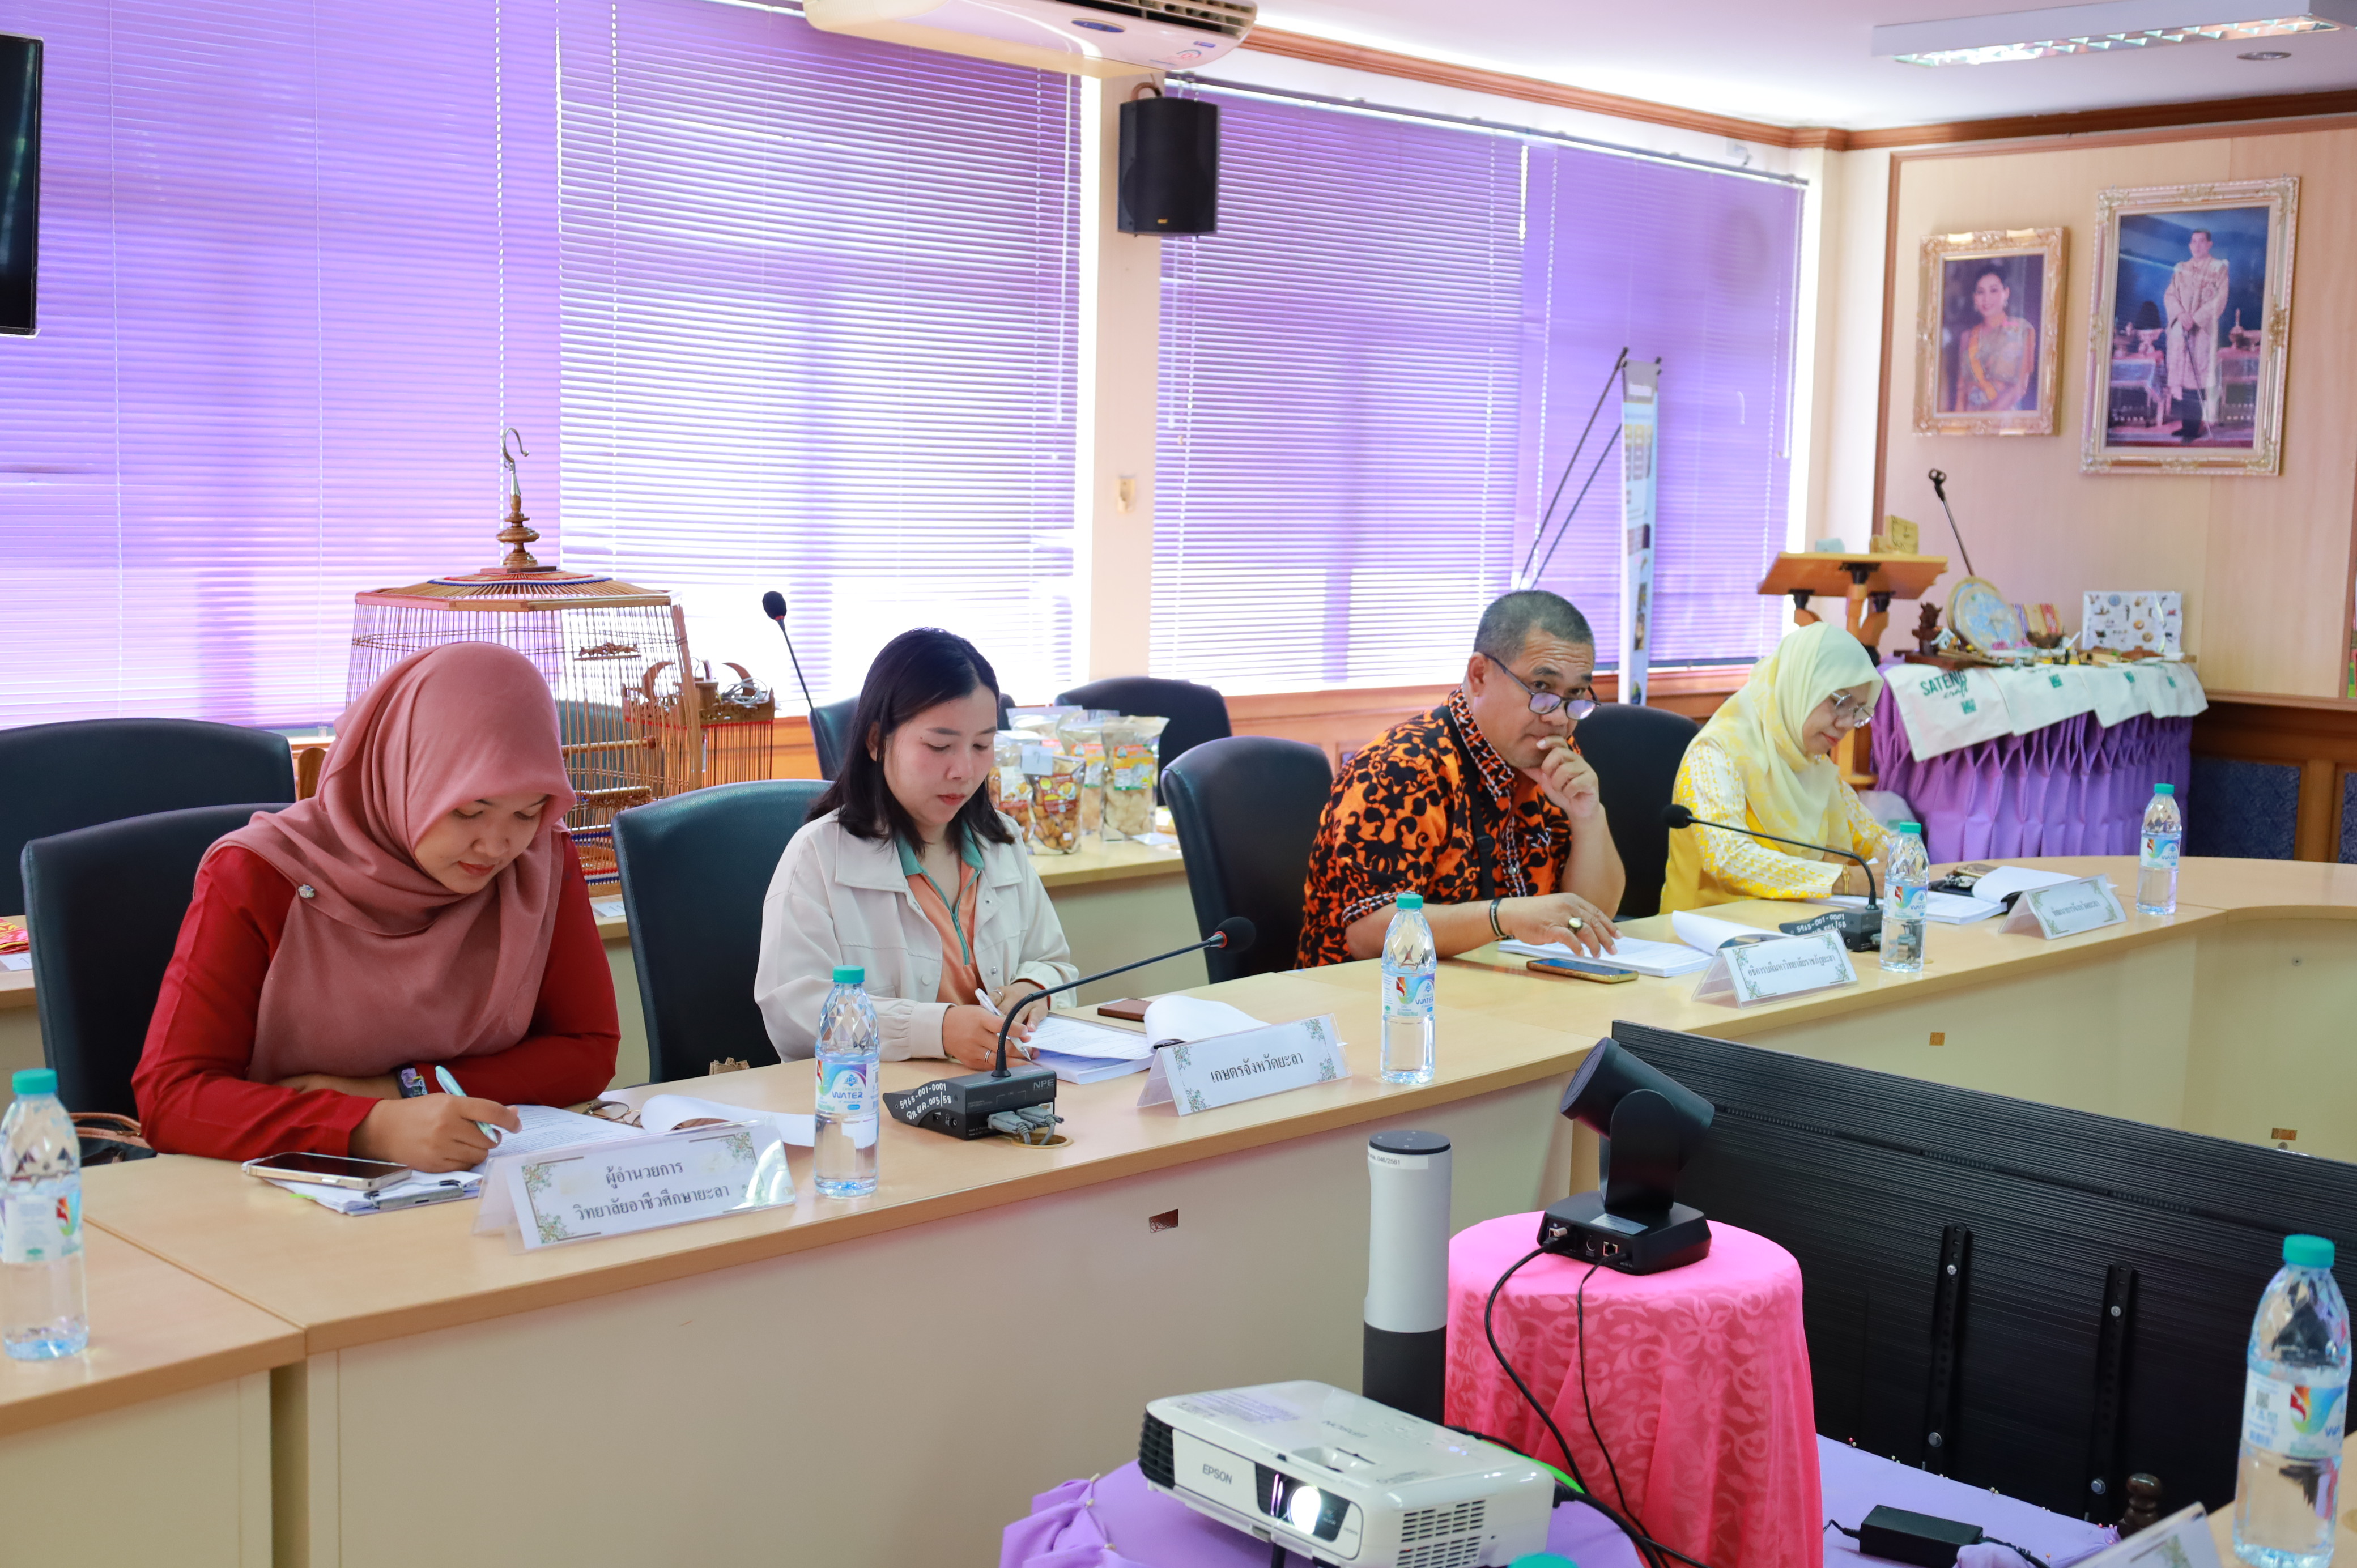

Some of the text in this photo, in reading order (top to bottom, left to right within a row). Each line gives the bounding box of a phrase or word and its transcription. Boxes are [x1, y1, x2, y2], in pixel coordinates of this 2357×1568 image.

[1210, 1053, 1304, 1083] เกษตรจังหวัดยะลา
[899, 1082, 947, 1110] 5965-001-0001
[1033, 1079, 1054, 1089] NPE
[605, 1162, 684, 1189] ผู้อำนวยการ
[572, 1184, 730, 1221] วิทยาลัยอาชีวศึกษายะลา
[1202, 1463, 1233, 1485] EPSON
